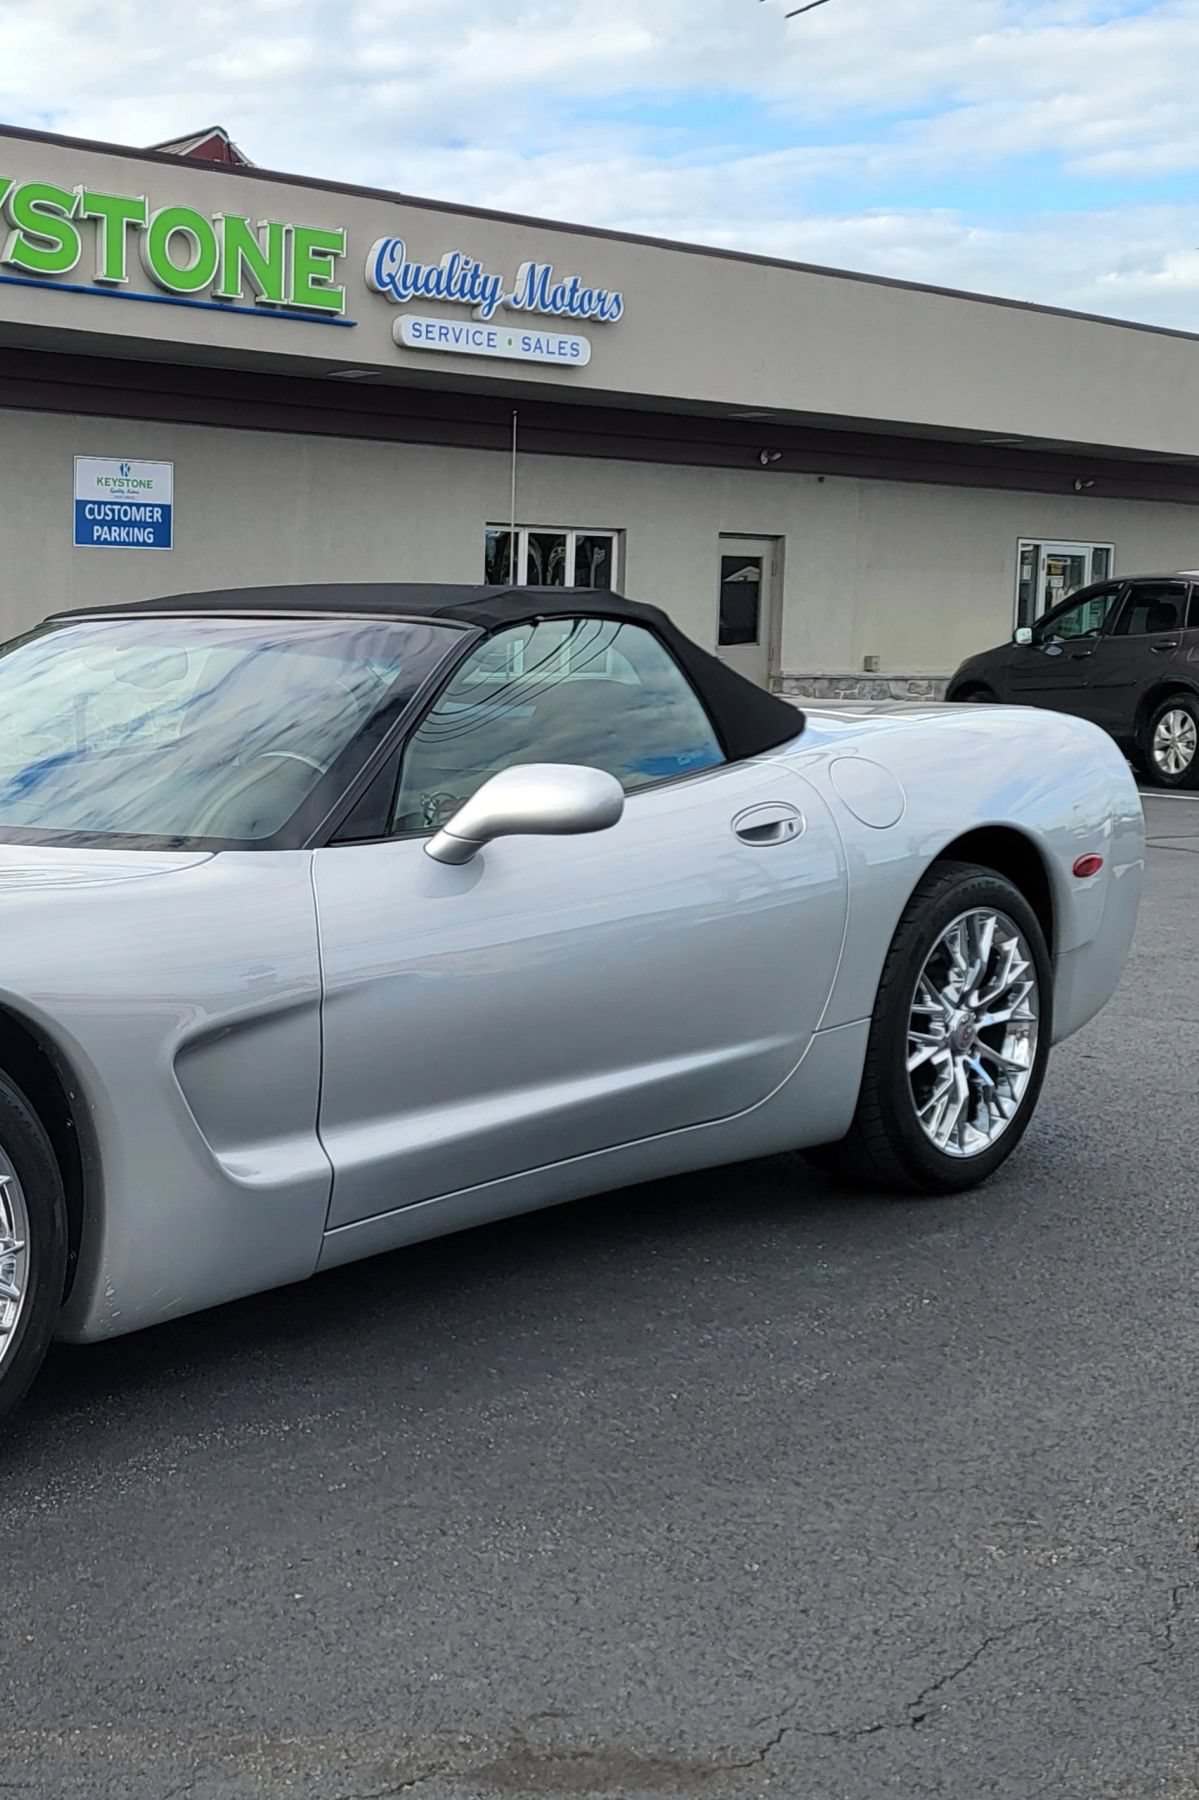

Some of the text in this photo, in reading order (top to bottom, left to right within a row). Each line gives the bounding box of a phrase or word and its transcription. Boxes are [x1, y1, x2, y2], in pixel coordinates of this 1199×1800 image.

[371, 237, 623, 321] Quality Motors
[411, 321, 580, 358] SERVICE SALES
[96, 476, 153, 489] KEYSTONE
[85, 503, 162, 523] CUSTOMER
[93, 525, 154, 543] PARKING
